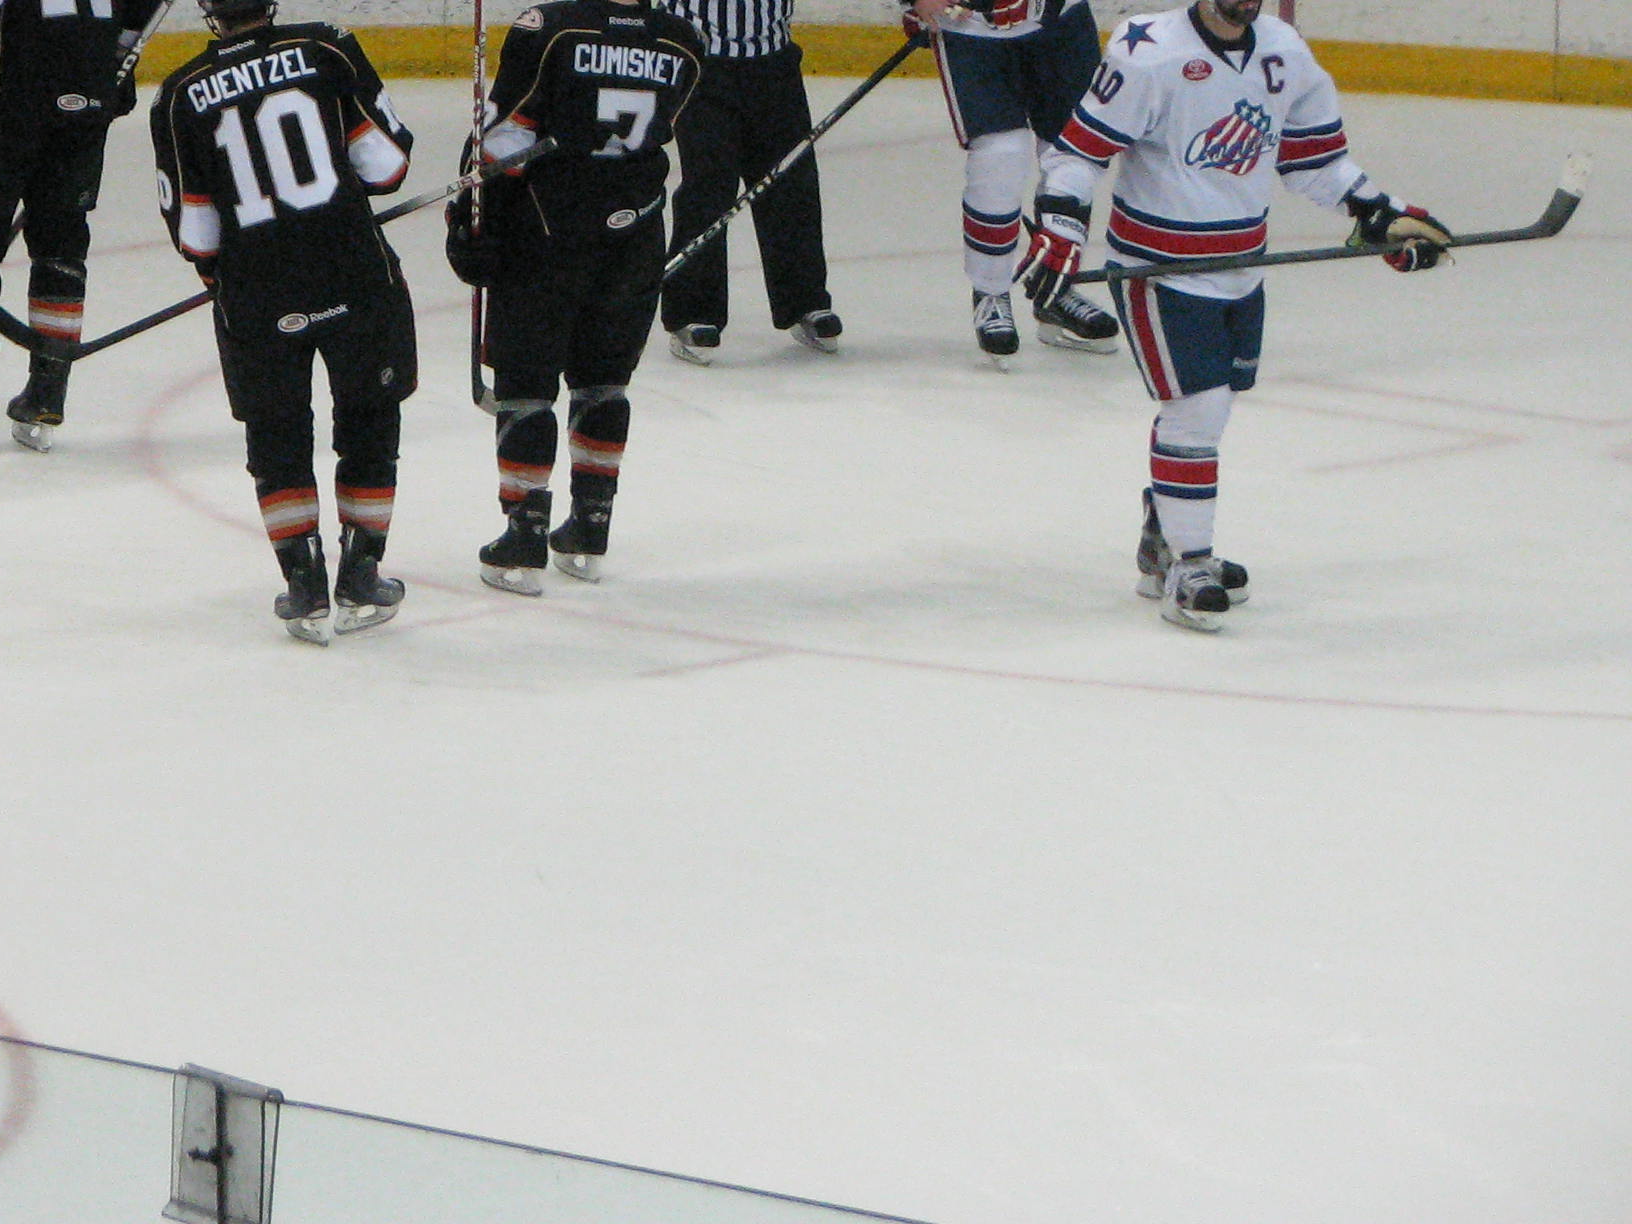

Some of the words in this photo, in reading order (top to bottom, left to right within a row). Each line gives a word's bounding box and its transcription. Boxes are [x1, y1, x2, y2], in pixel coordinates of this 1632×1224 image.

[608, 16, 647, 27] Reebok
[217, 38, 258, 56] Reebok
[573, 43, 685, 86] CUMISKEY
[188, 47, 318, 114] GUENTZEL
[1261, 54, 1285, 95] C
[590, 88, 656, 156] 7
[216, 86, 340, 229] 10
[309, 303, 348, 324] Reebok
